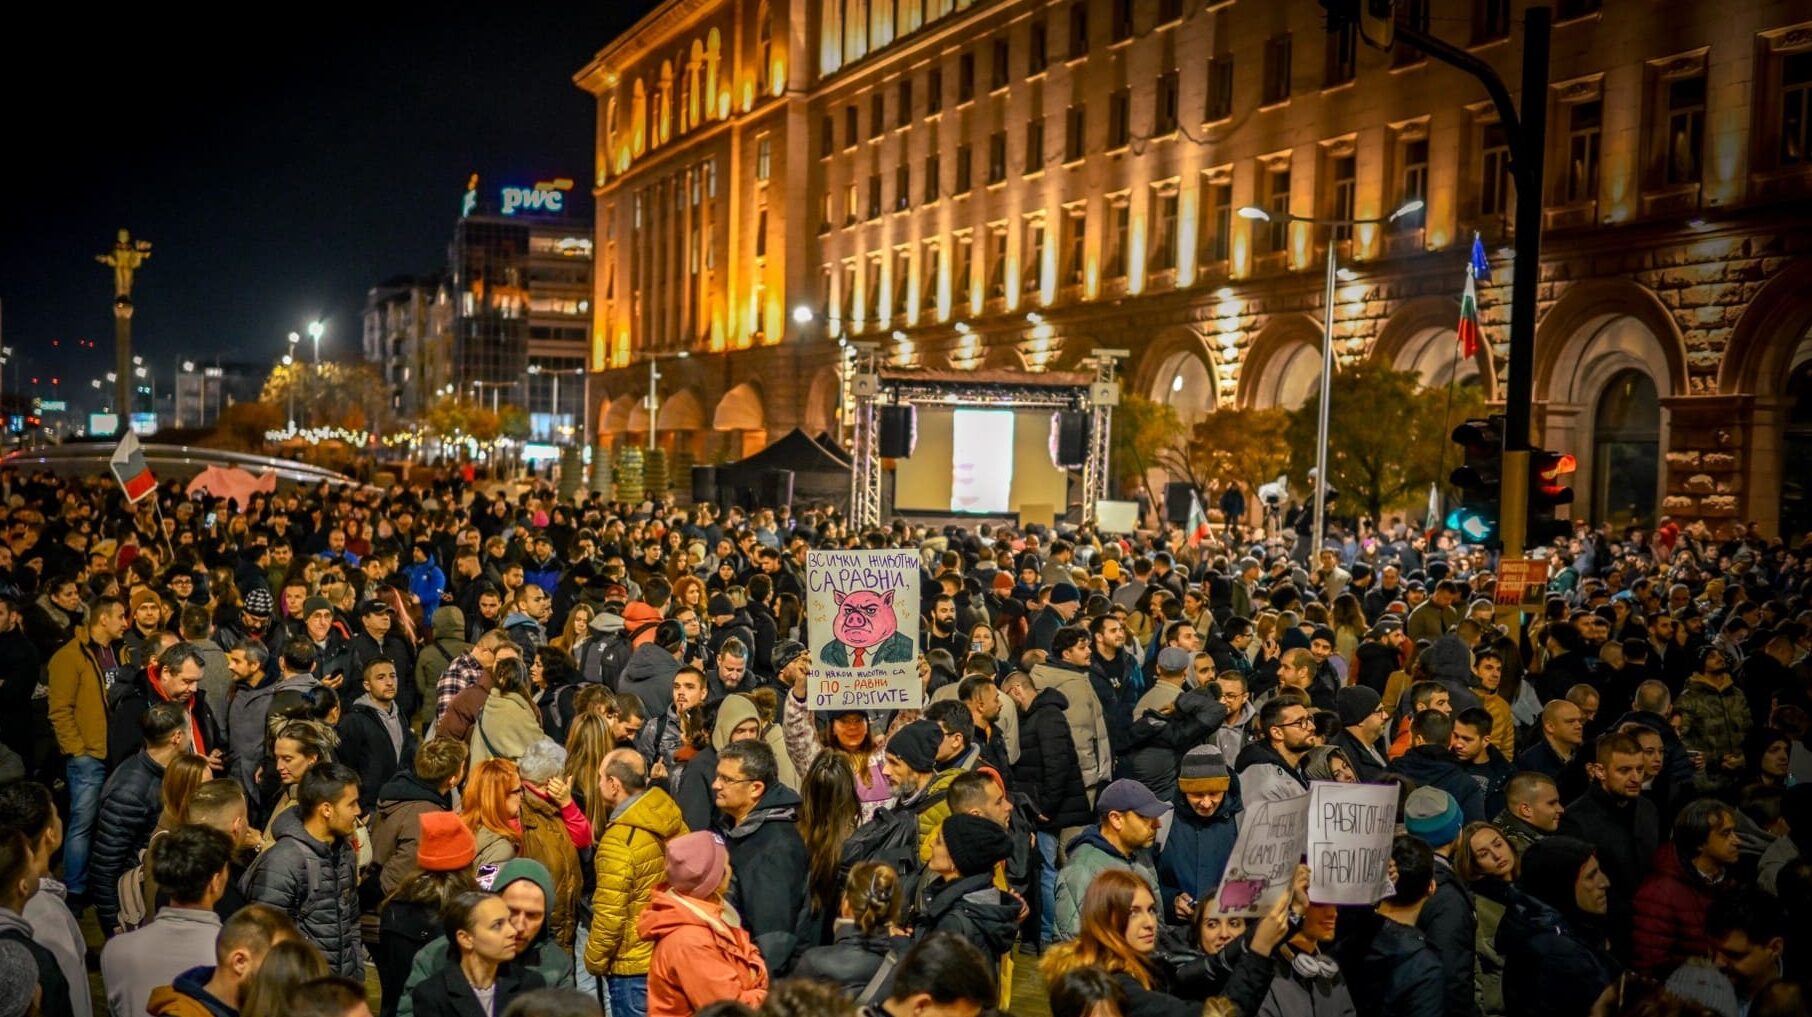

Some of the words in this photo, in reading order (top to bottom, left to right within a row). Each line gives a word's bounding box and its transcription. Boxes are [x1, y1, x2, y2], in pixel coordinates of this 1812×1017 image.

[501, 188, 563, 214] pwc
[809, 553, 861, 568] ВСИЧКИ
[869, 554, 918, 569] ЖИВОТНИ
[817, 694, 833, 706] ОТ
[843, 689, 909, 705] ДРУГИТЕ
